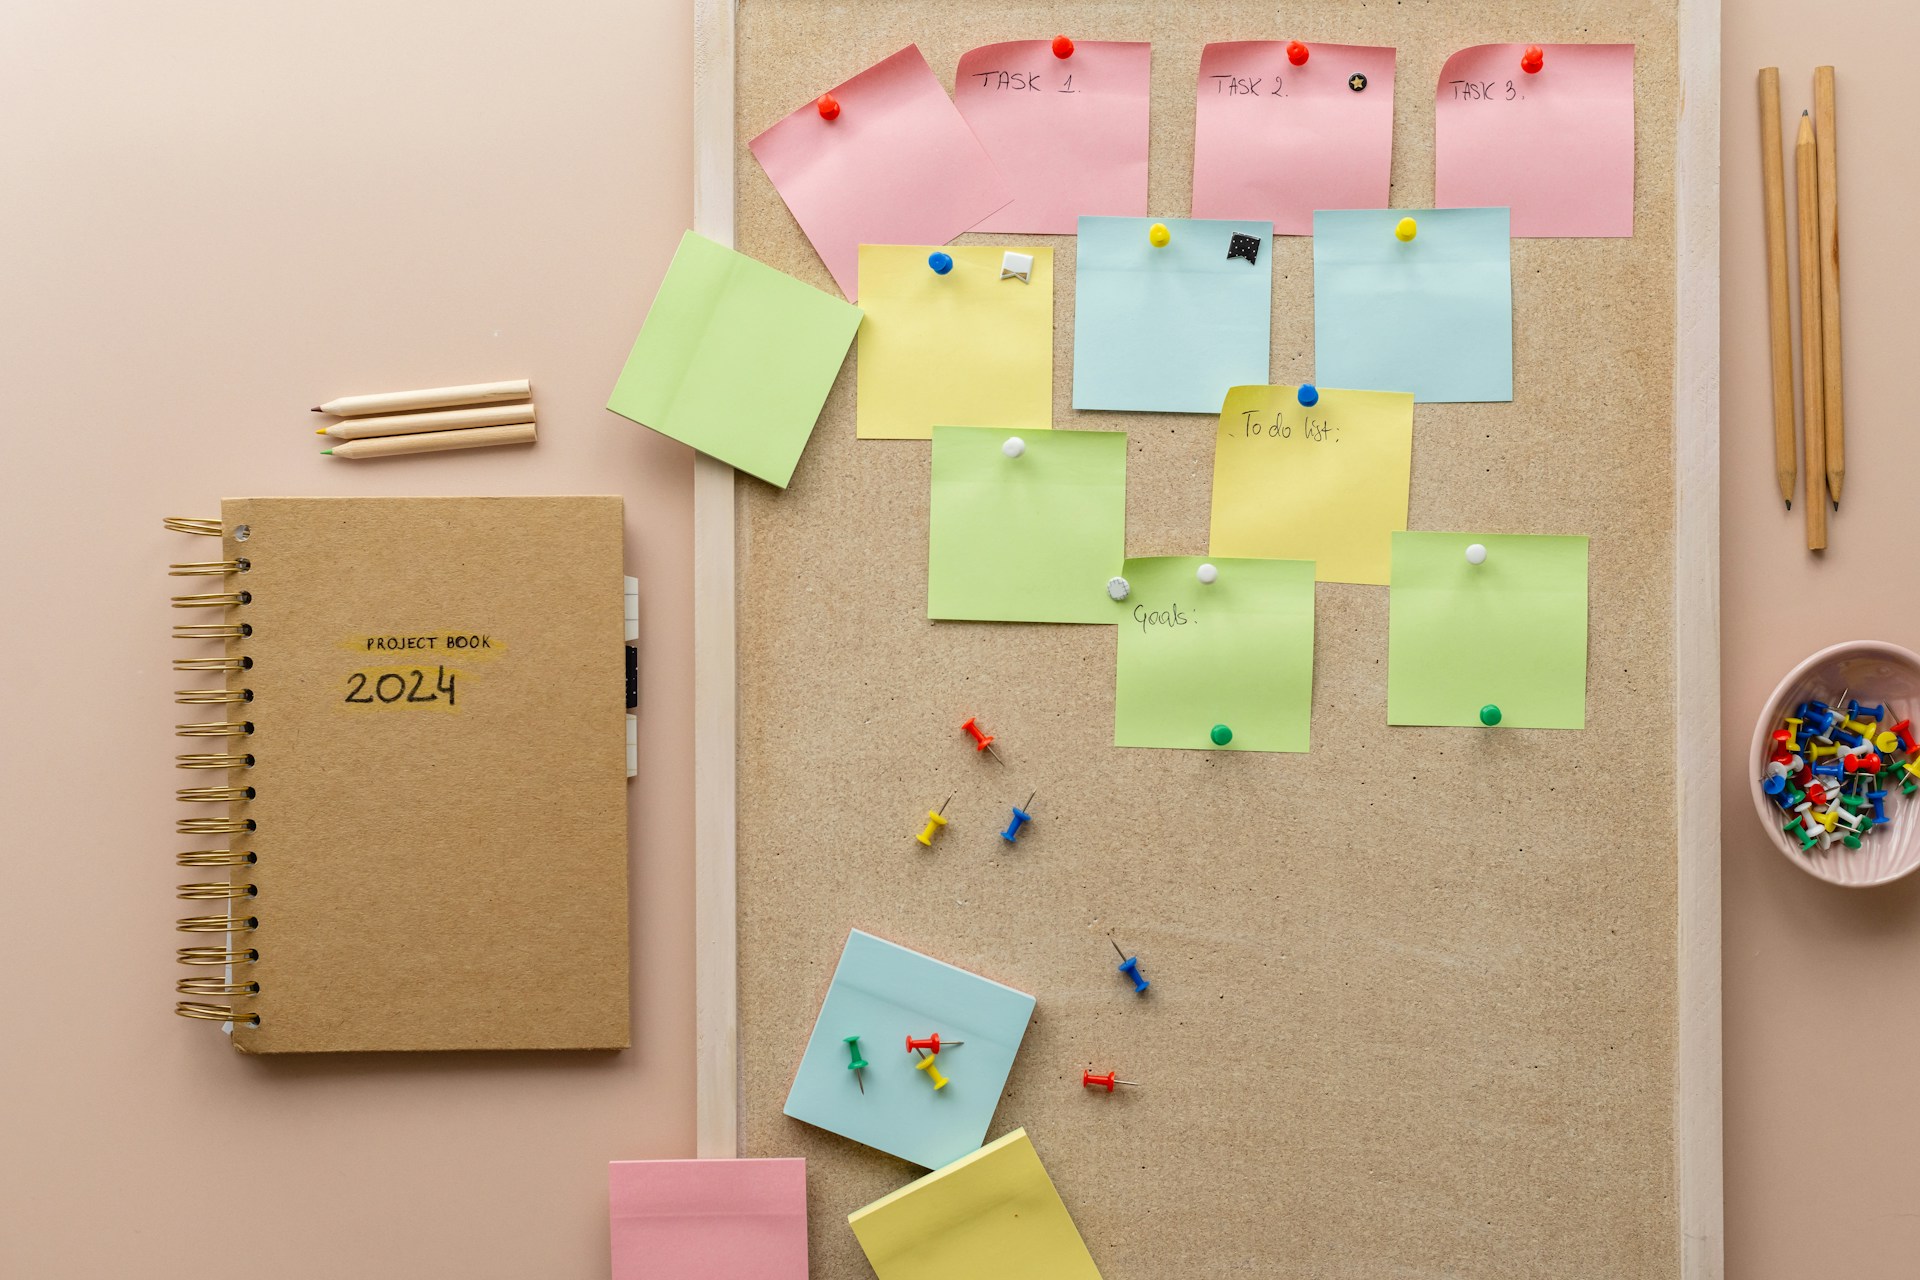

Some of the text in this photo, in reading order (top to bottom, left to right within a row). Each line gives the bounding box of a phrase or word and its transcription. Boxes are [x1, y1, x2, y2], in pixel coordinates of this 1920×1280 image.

[972, 70, 1081, 93] TASK 1.
[1209, 74, 1289, 97] TASK 2.
[1449, 80, 1525, 101] TASK 3.
[1241, 409, 1262, 438] To
[1268, 412, 1292, 439] do
[1133, 603, 1198, 634] Goals:
[367, 634, 491, 650] PROJECT BOOK
[344, 665, 455, 705] 2024
